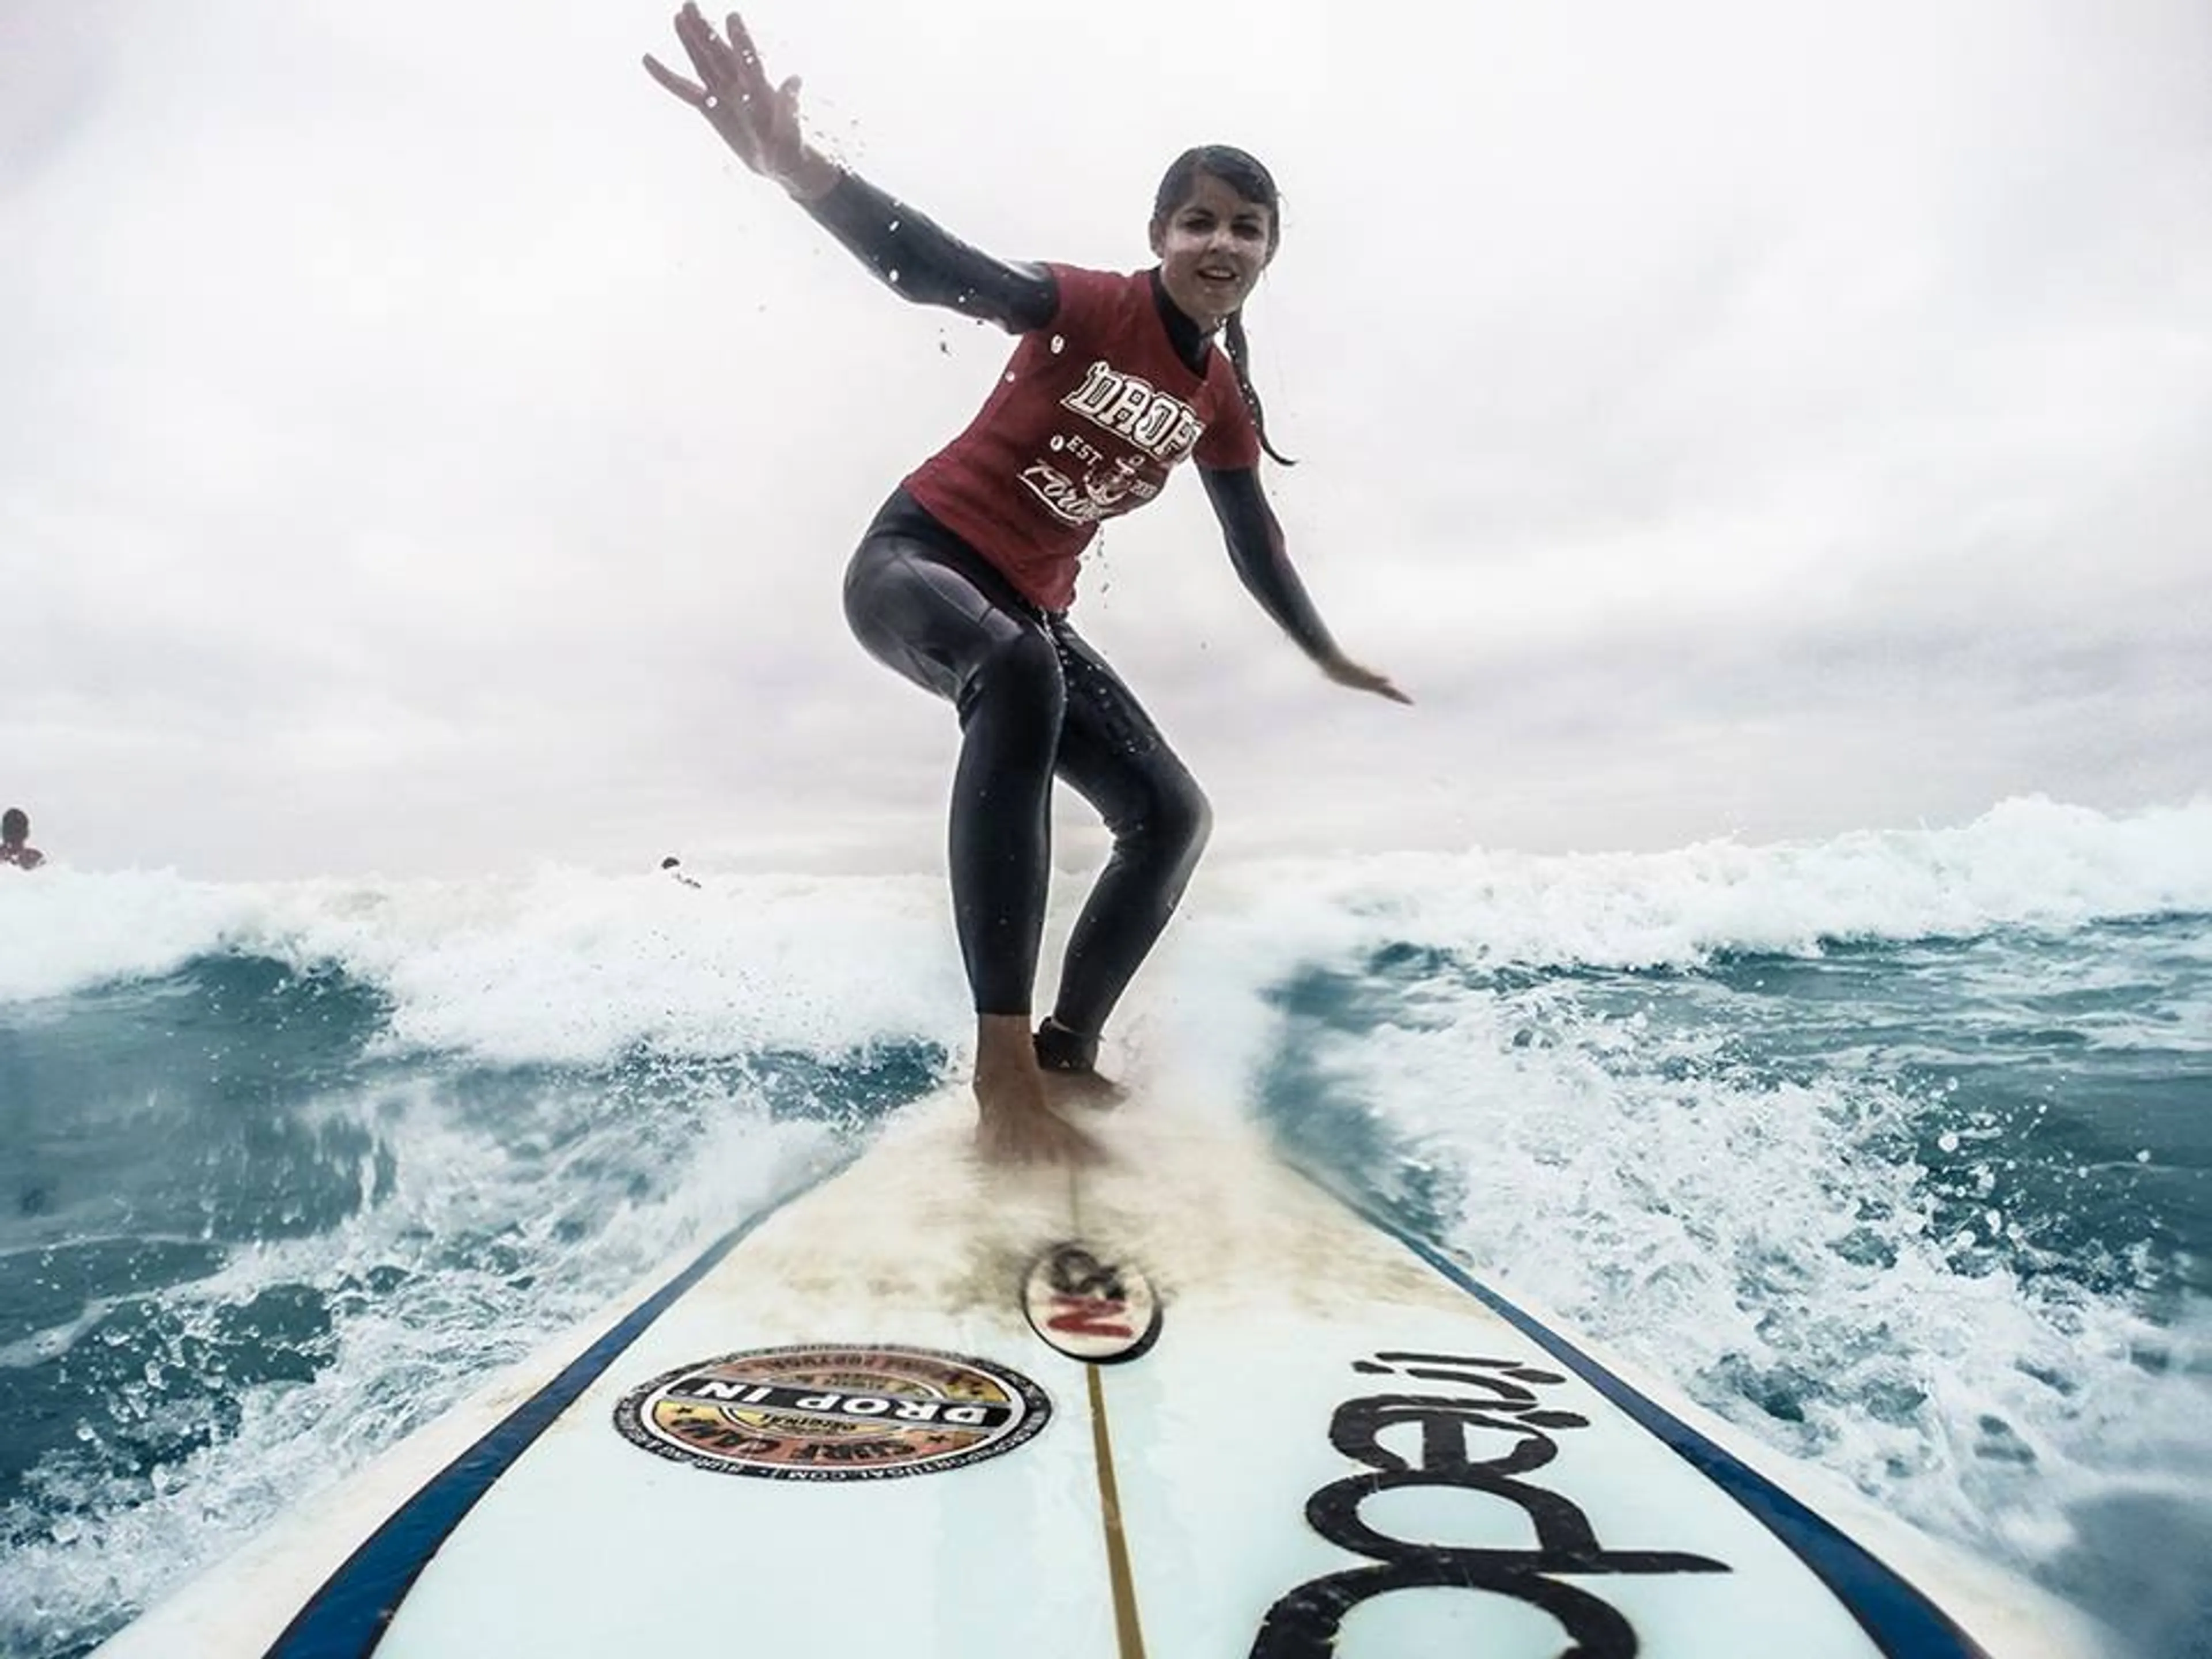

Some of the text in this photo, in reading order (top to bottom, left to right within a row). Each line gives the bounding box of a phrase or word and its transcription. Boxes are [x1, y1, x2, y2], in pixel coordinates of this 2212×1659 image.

[1066, 436, 1103, 465] EST
[699, 1381, 771, 1406] IN
[796, 1394, 987, 1424] DROP
[792, 1441, 915, 1460] SURF
